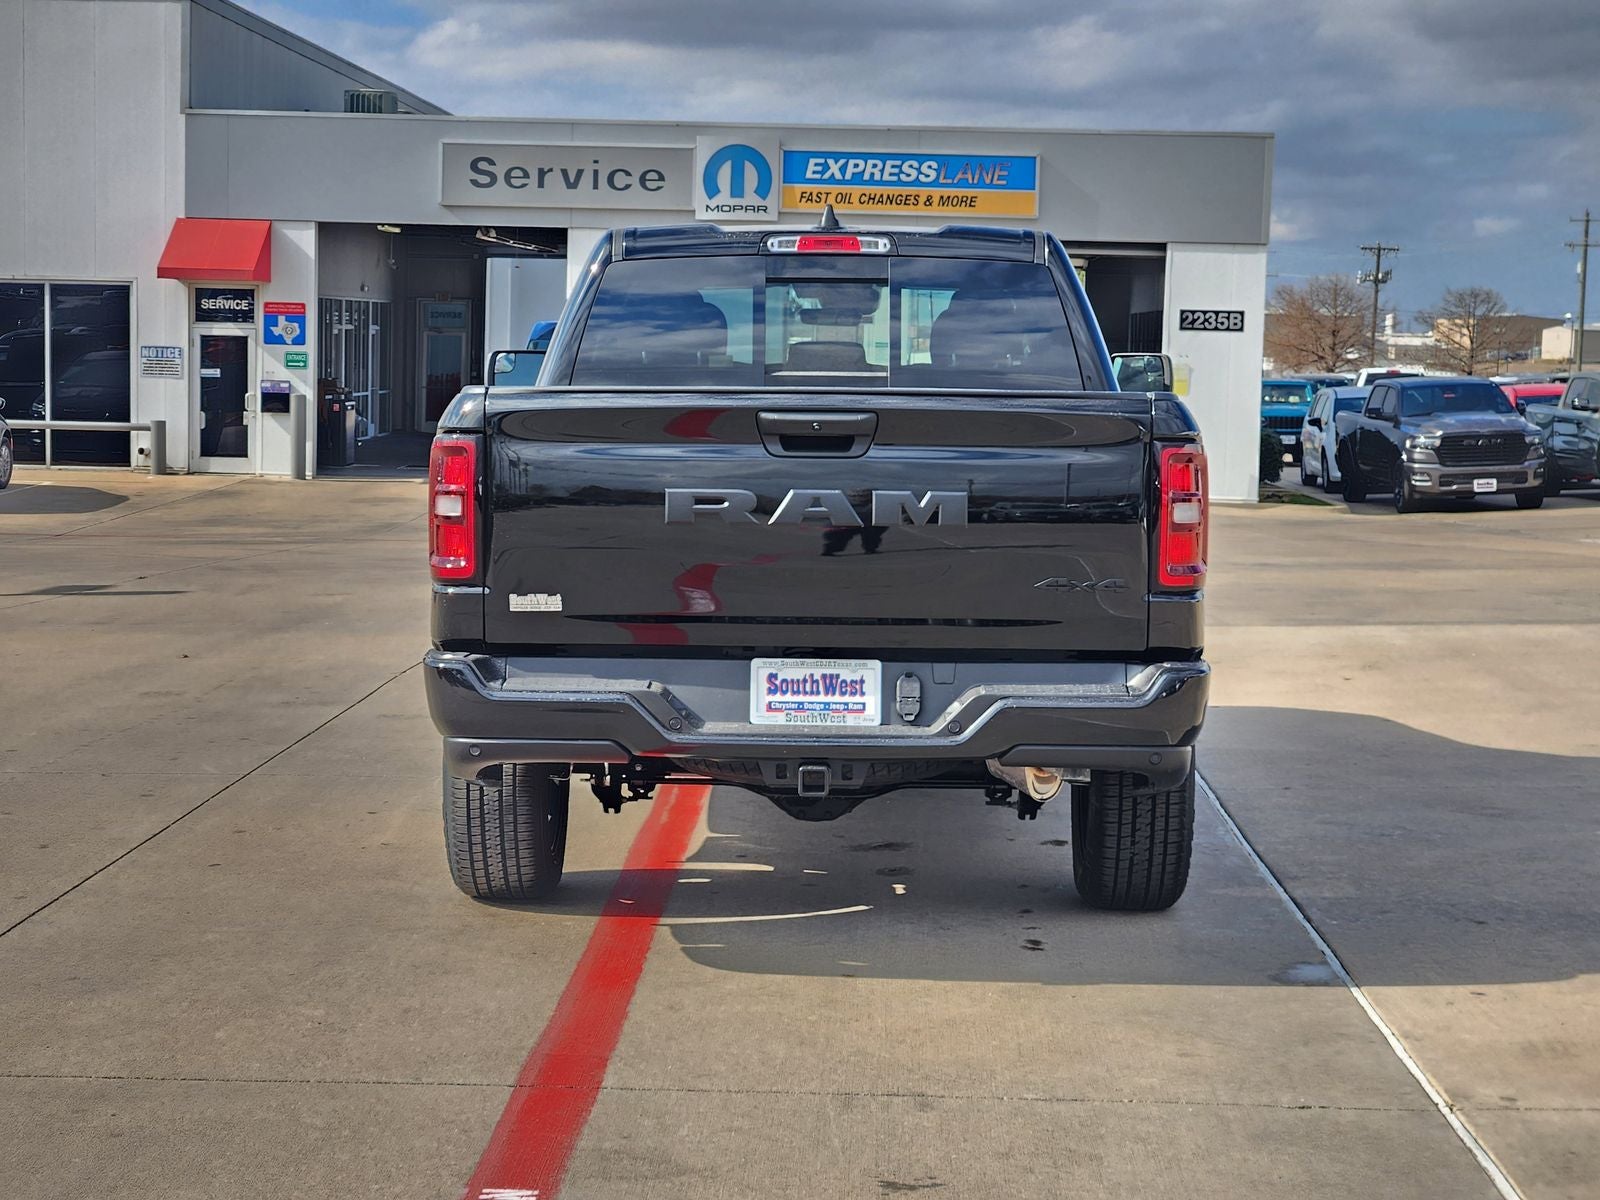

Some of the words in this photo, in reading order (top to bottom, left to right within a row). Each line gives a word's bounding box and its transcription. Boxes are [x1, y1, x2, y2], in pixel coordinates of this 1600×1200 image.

[469, 156, 666, 192] Service
[799, 191, 832, 204] FAST
[835, 192, 854, 205] OIL
[858, 193, 920, 207] CHANGES
[923, 194, 934, 207] &
[938, 195, 978, 208] MORE
[705, 204, 770, 214] MOPAR
[200, 299, 250, 310] SERVICE
[1181, 311, 1243, 330] 2235B
[141, 347, 181, 359] NOTICE
[664, 488, 969, 527] RAM
[766, 671, 866, 698] SouthWest
[771, 702, 799, 710] Chrysler
[803, 702, 825, 711] Dodge
[829, 702, 845, 711] Jeep
[848, 702, 864, 710] Ram
[785, 712, 848, 724] SouthWest
